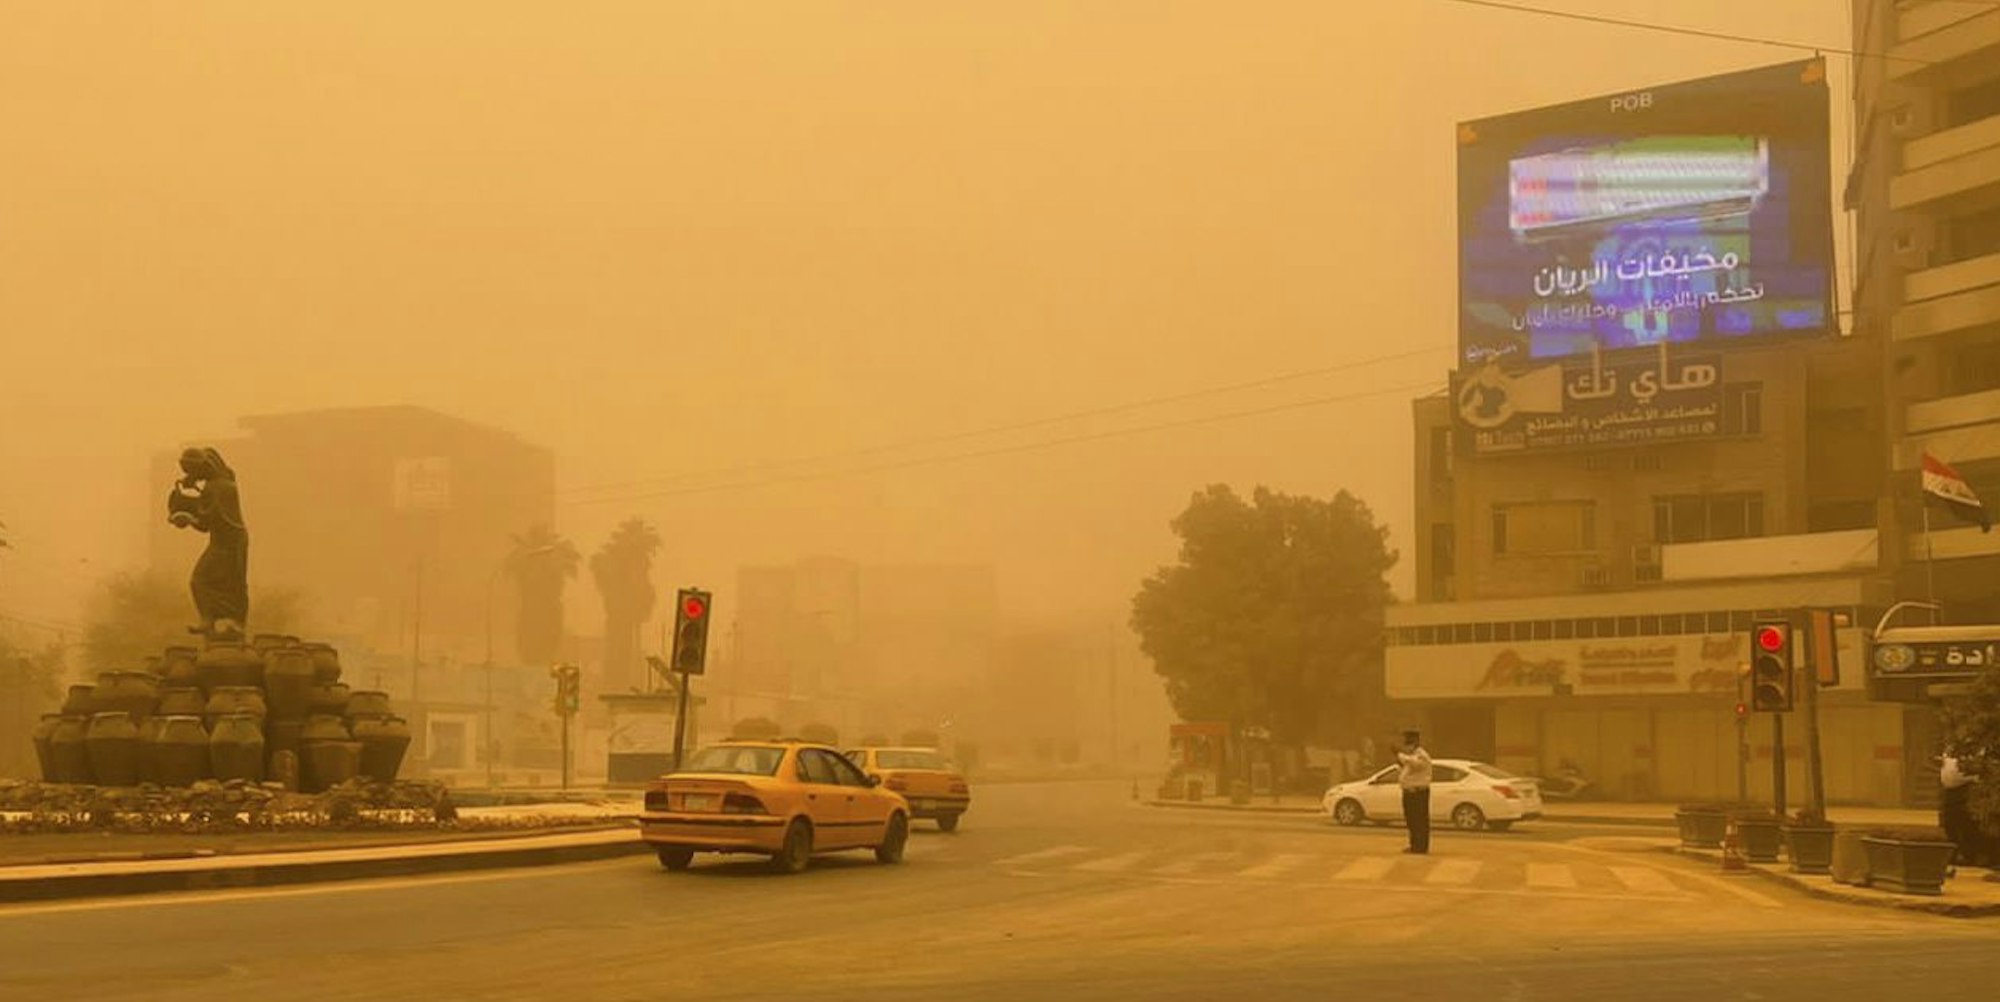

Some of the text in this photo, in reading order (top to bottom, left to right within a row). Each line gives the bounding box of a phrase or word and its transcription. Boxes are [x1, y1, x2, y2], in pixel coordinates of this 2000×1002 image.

[1533, 259, 1608, 296] الريان
[1567, 341, 1716, 403] هاي تك
